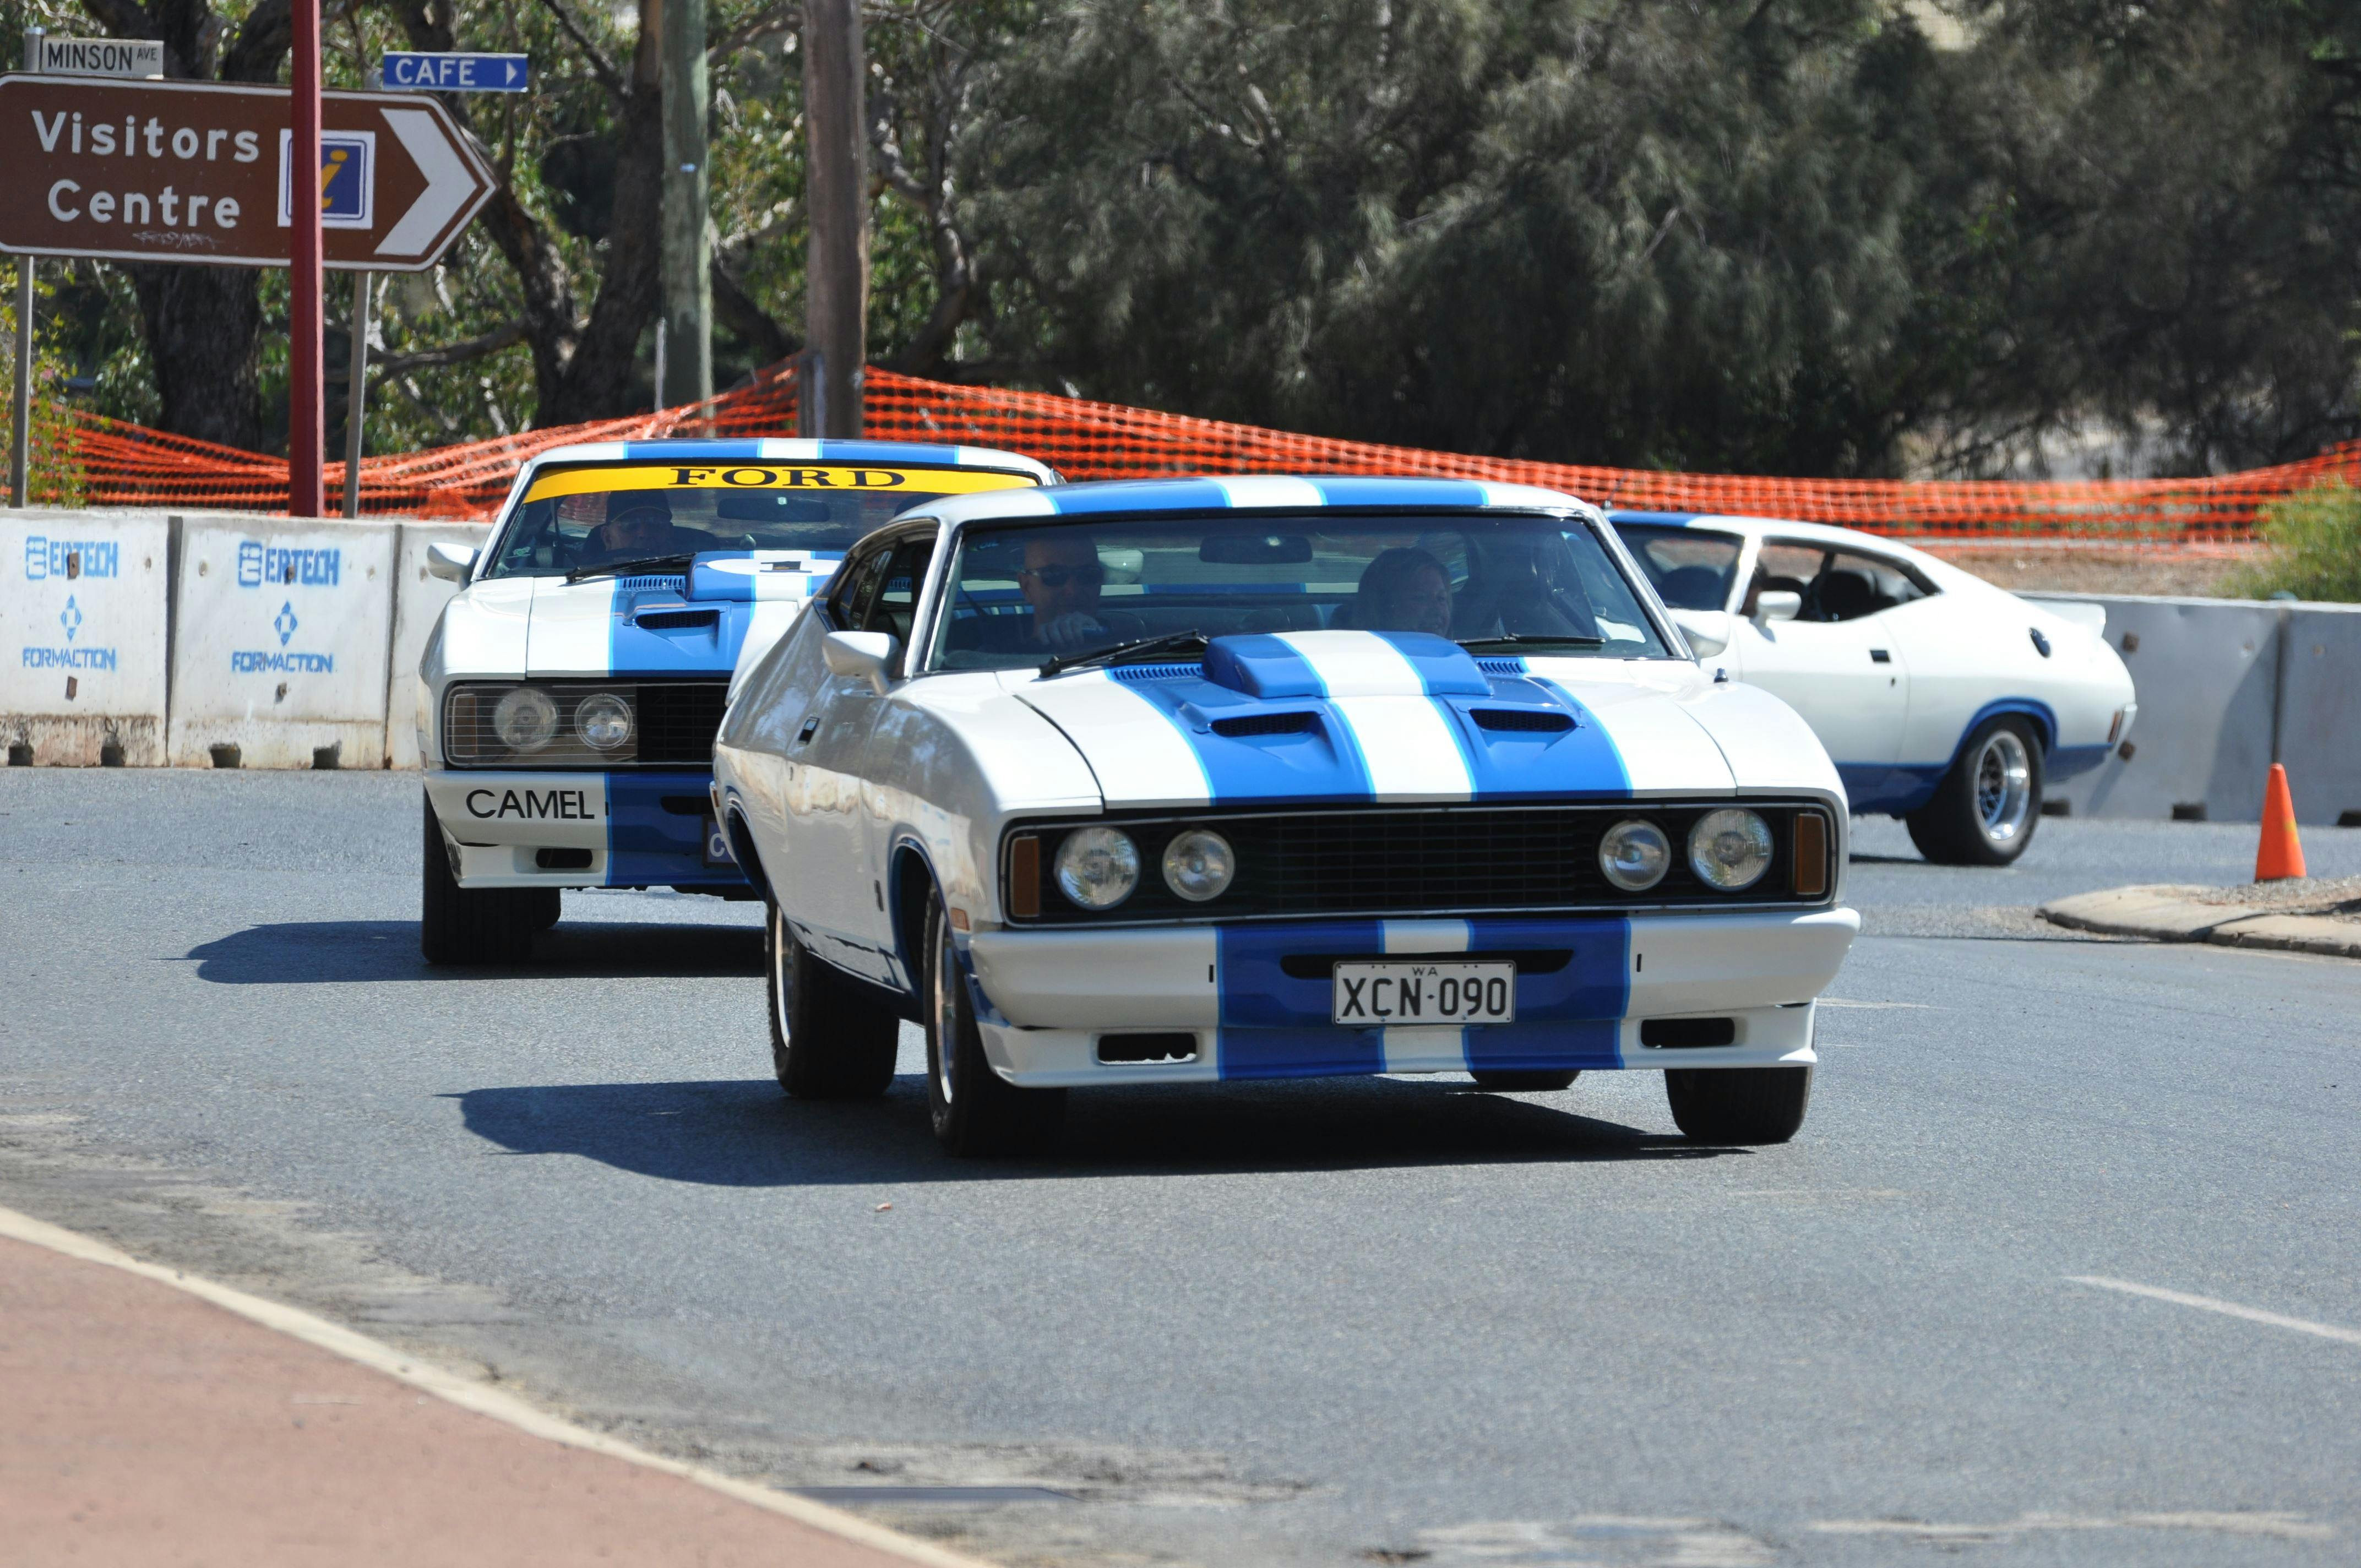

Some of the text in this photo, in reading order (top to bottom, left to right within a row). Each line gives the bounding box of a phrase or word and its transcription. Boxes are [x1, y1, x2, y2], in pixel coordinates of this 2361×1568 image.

[47, 42, 157, 71] MINSON AVE
[395, 57, 476, 86] CAFE
[31, 110, 260, 164] Visitors
[47, 178, 241, 229] Centre
[667, 467, 906, 487] FORD
[265, 548, 339, 586] ERTECH
[22, 647, 117, 672] FORMACTION
[231, 651, 334, 674] FORMACTION
[466, 789, 595, 820] CAMEL
